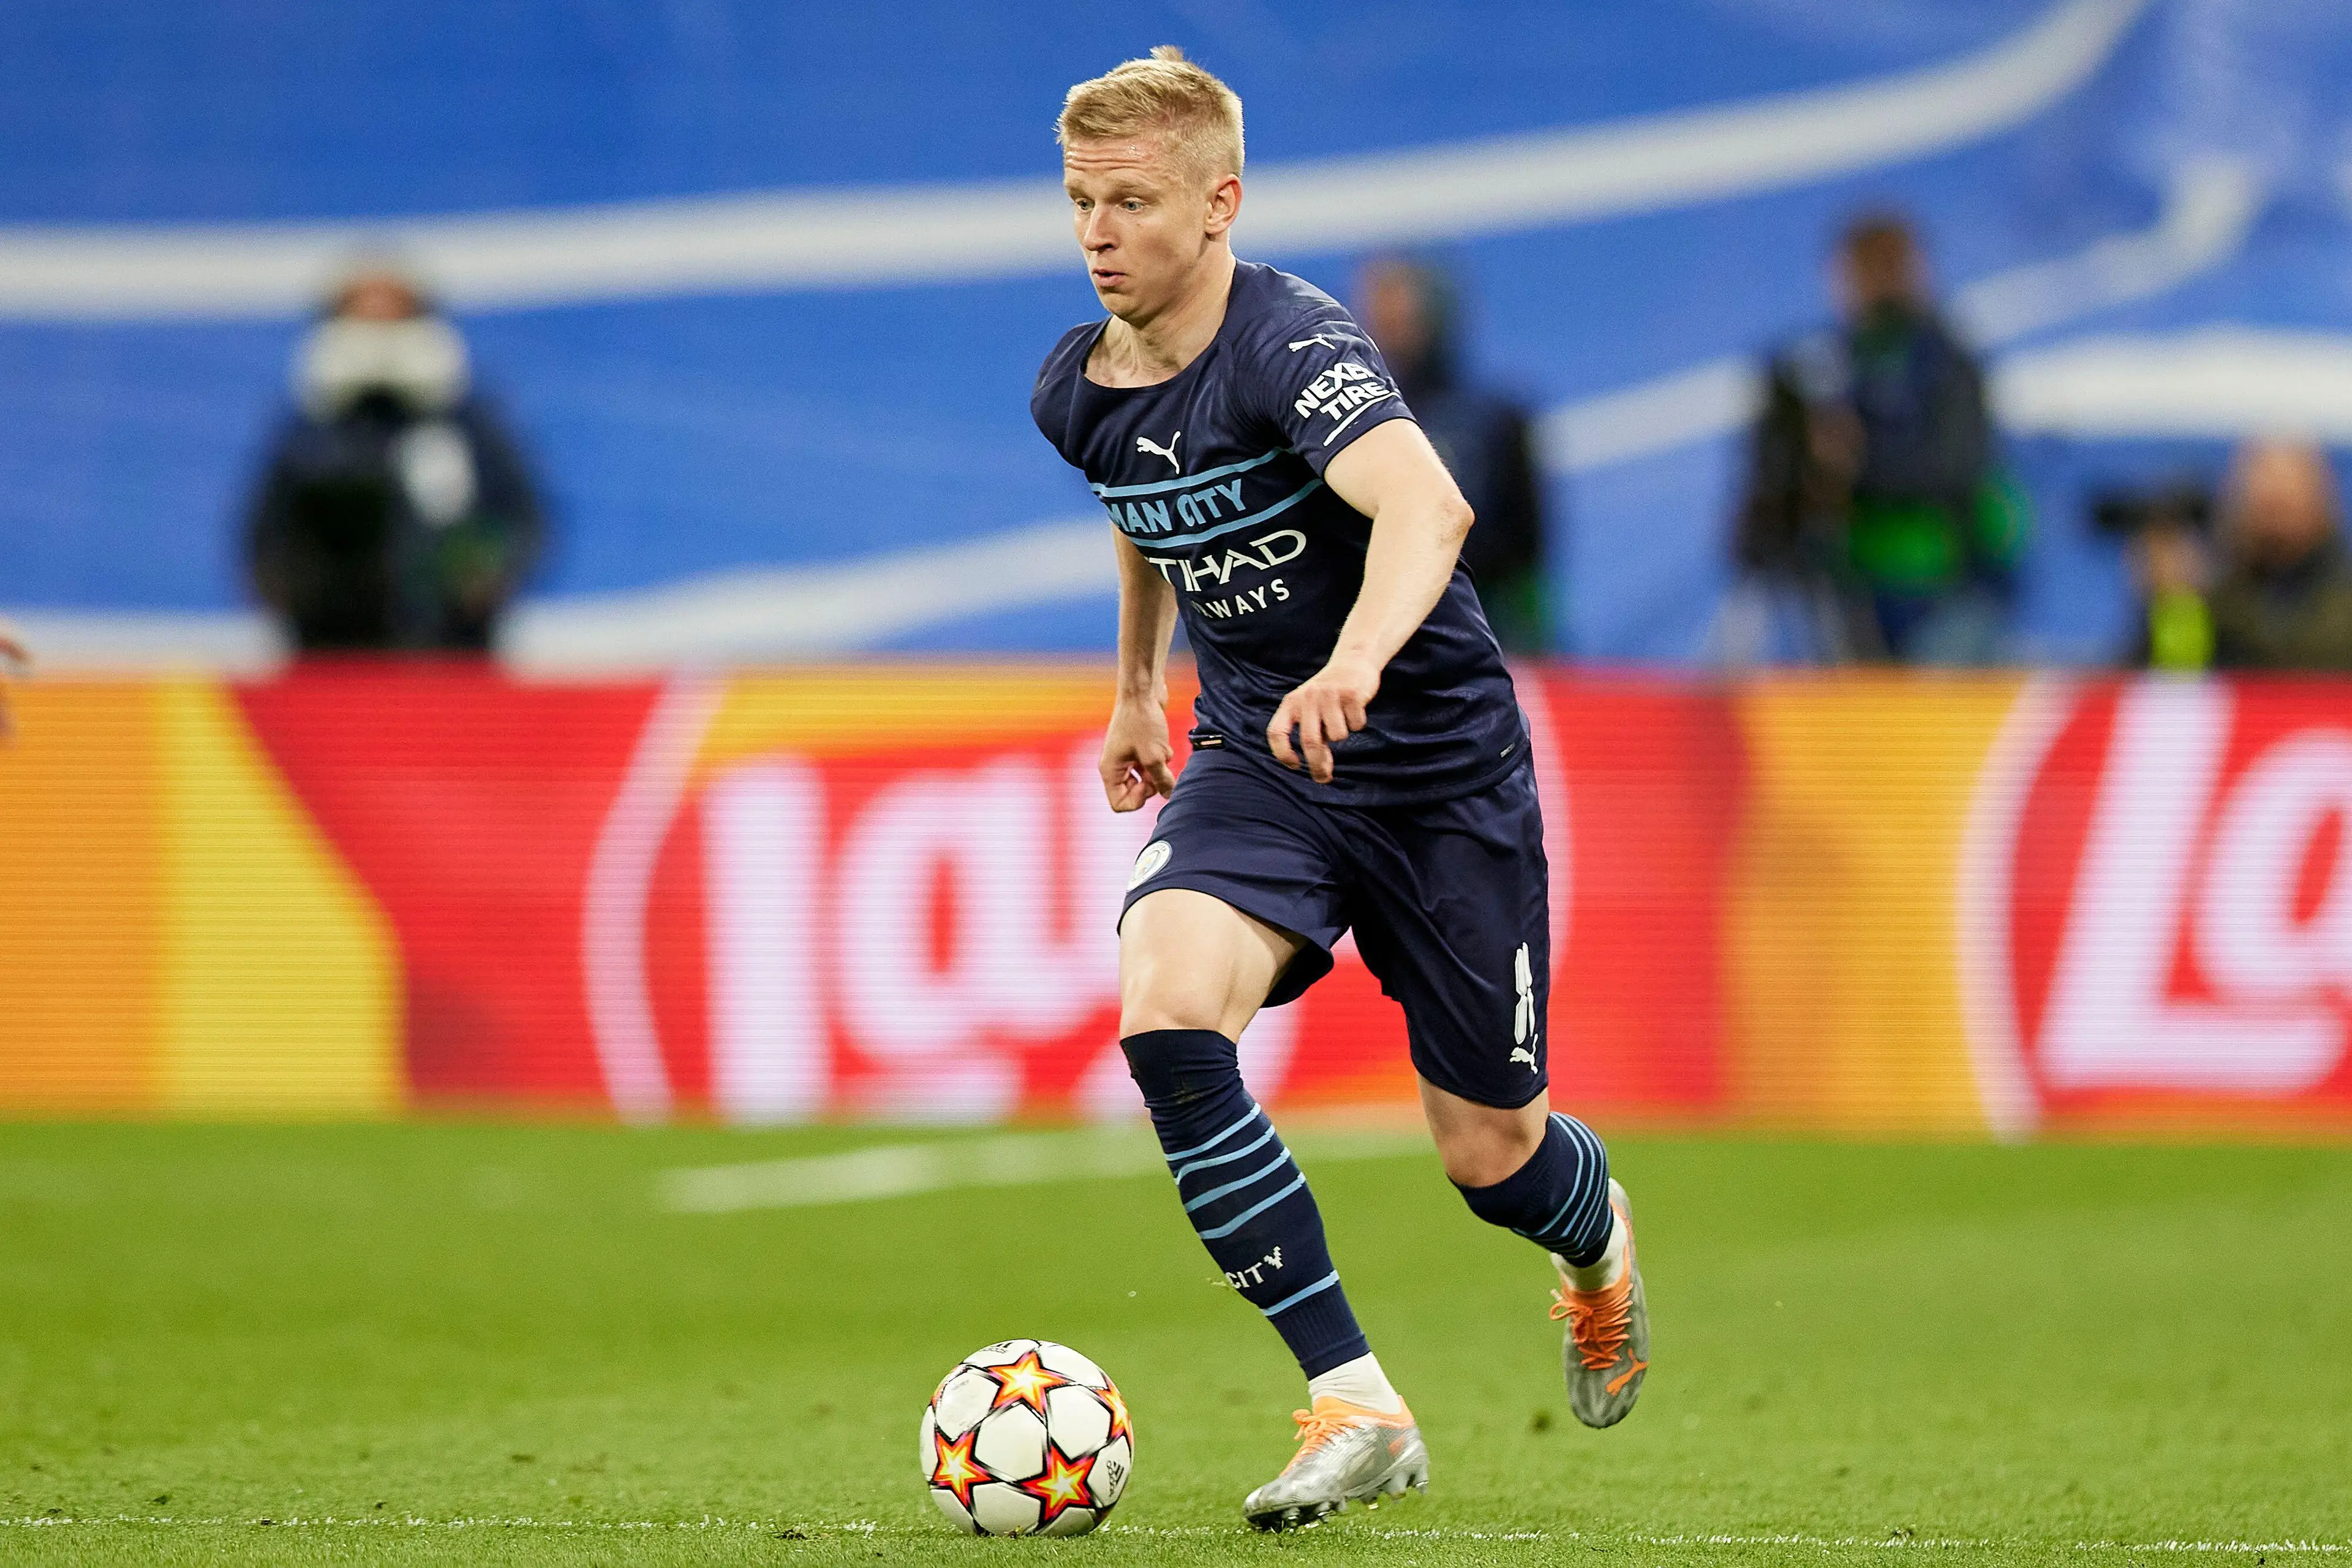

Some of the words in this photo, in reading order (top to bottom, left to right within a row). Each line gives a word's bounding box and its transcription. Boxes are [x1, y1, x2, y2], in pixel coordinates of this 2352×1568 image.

[1319, 382, 1390, 421] TIRE
[1105, 500, 1172, 533] MAN
[1177, 479, 1246, 527] CITY
[1144, 529, 1306, 592] TIHAD
[1224, 1246, 1284, 1289] CITY
